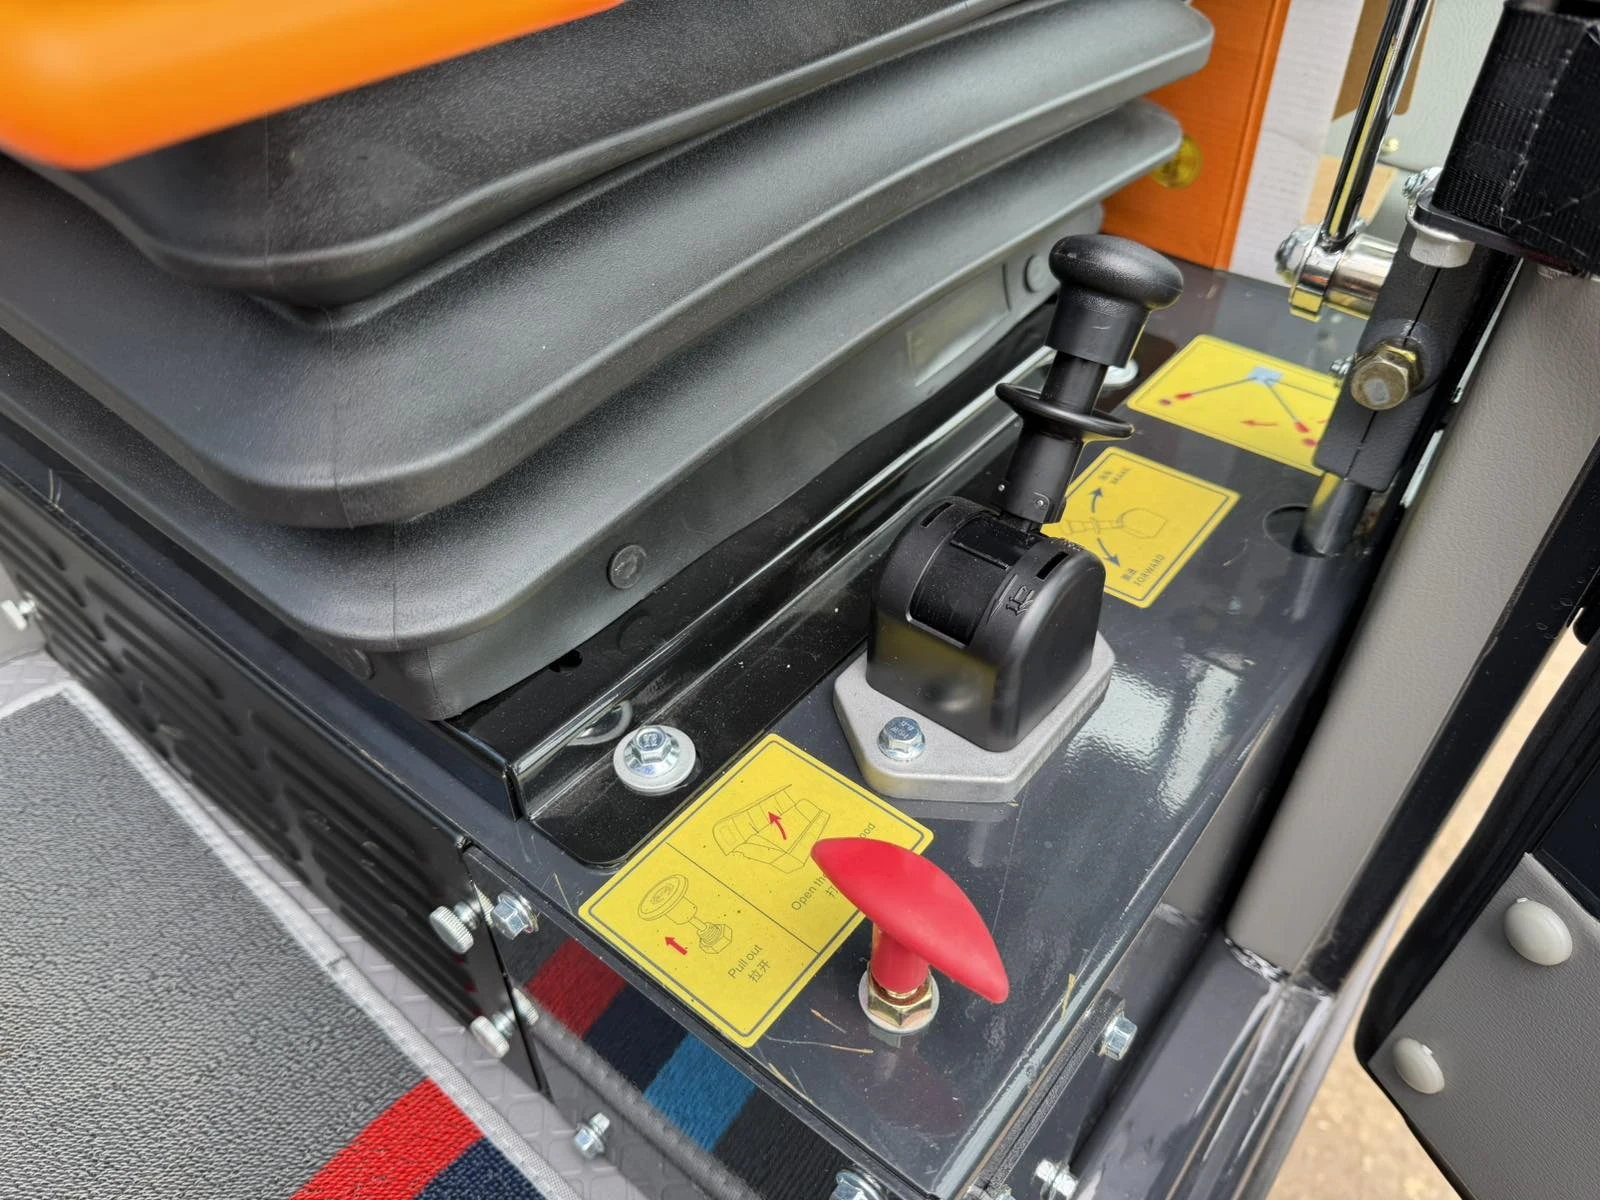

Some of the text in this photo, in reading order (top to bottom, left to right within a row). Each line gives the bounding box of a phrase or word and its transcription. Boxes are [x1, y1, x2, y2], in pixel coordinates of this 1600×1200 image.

[1133, 554, 1164, 585] FORWARD
[791, 886, 816, 910] Open
[859, 823, 875, 839] ood
[825, 886, 838, 897] 打
[728, 944, 764, 979] Pull out
[748, 959, 770, 983] 拉开
